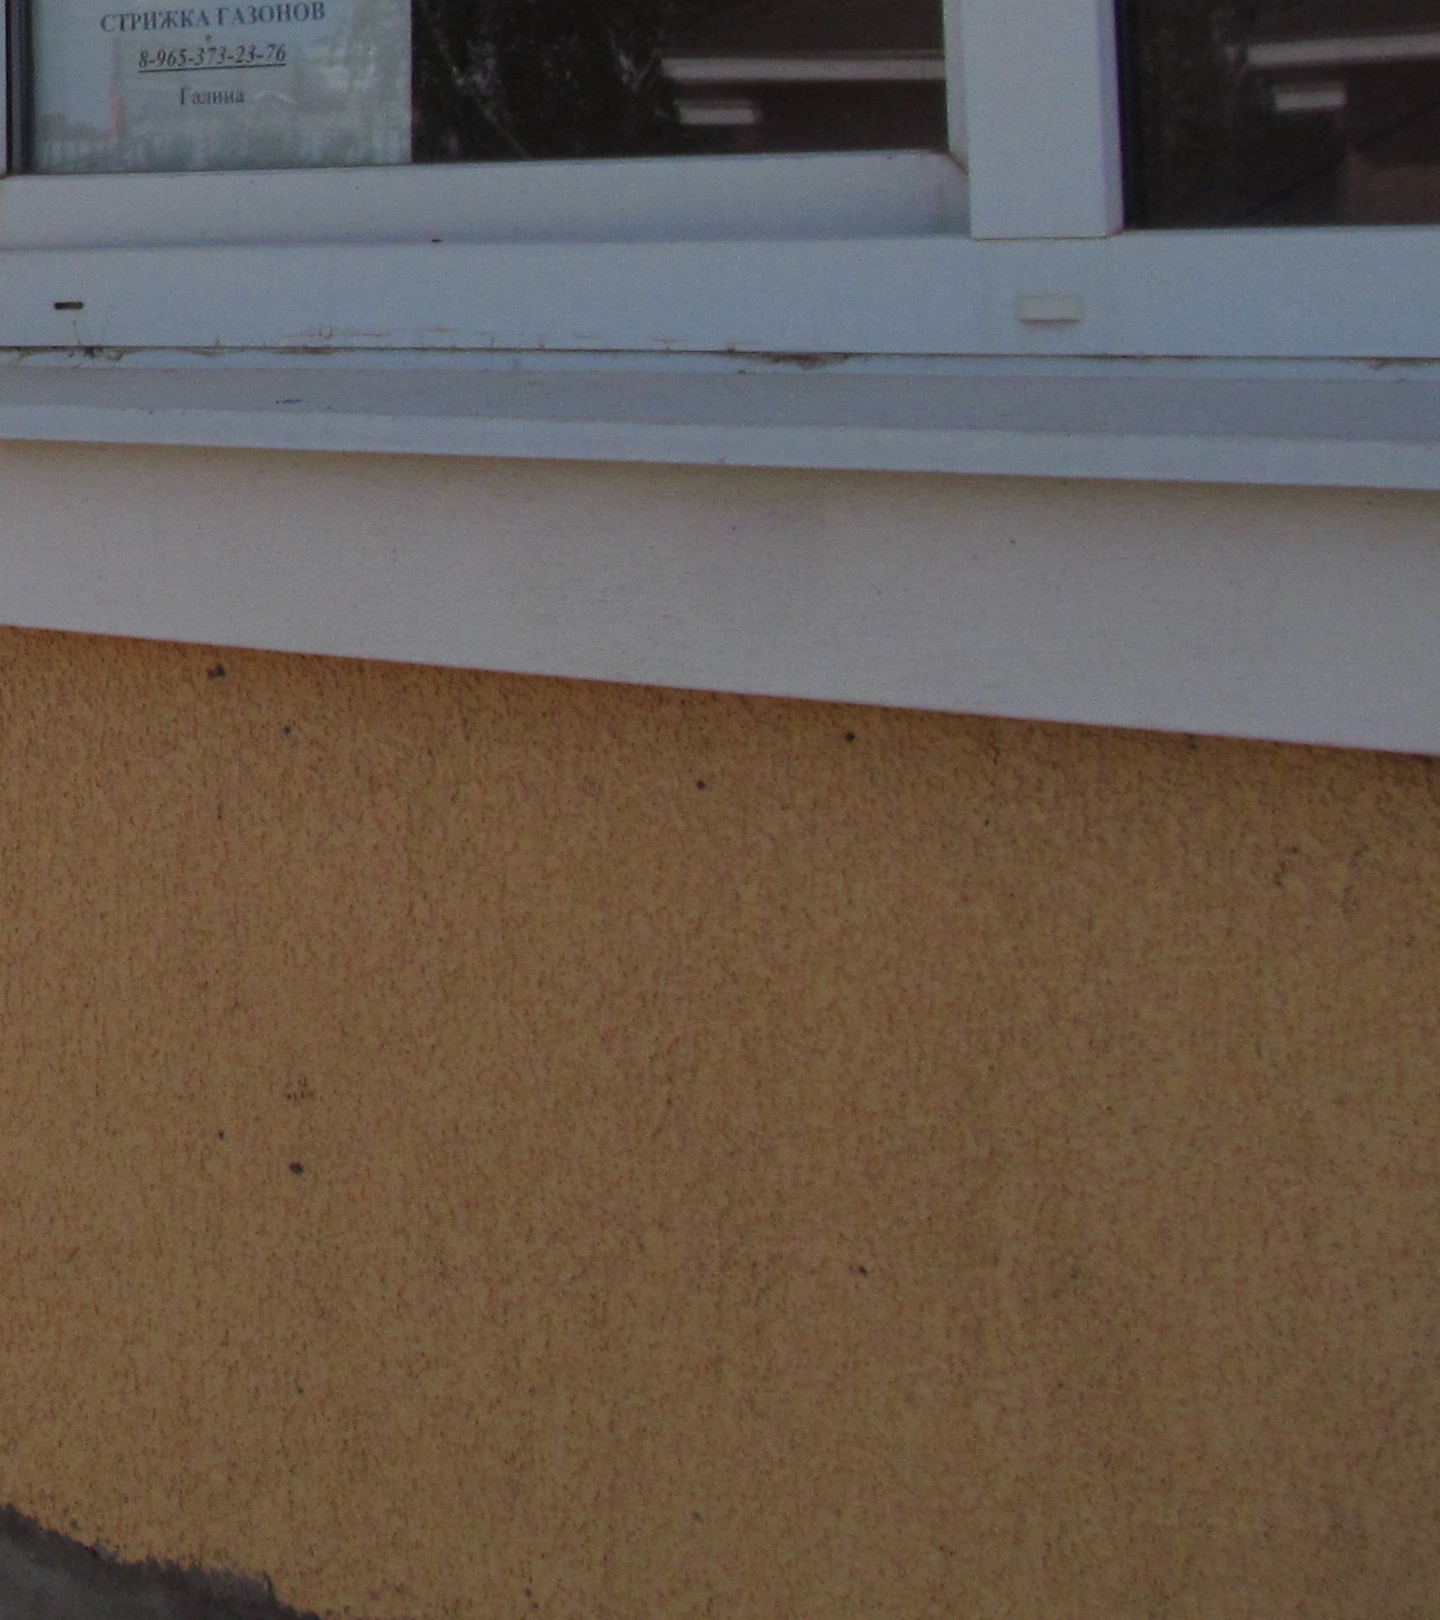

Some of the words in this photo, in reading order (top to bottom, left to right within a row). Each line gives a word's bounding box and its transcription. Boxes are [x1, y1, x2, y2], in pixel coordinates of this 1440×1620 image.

[99, 10, 210, 33] СТРИЖКА
[217, 1, 326, 28] ГАЗОНОВ
[138, 43, 287, 70] 8-965-373-23-76
[179, 86, 245, 106] Галина
